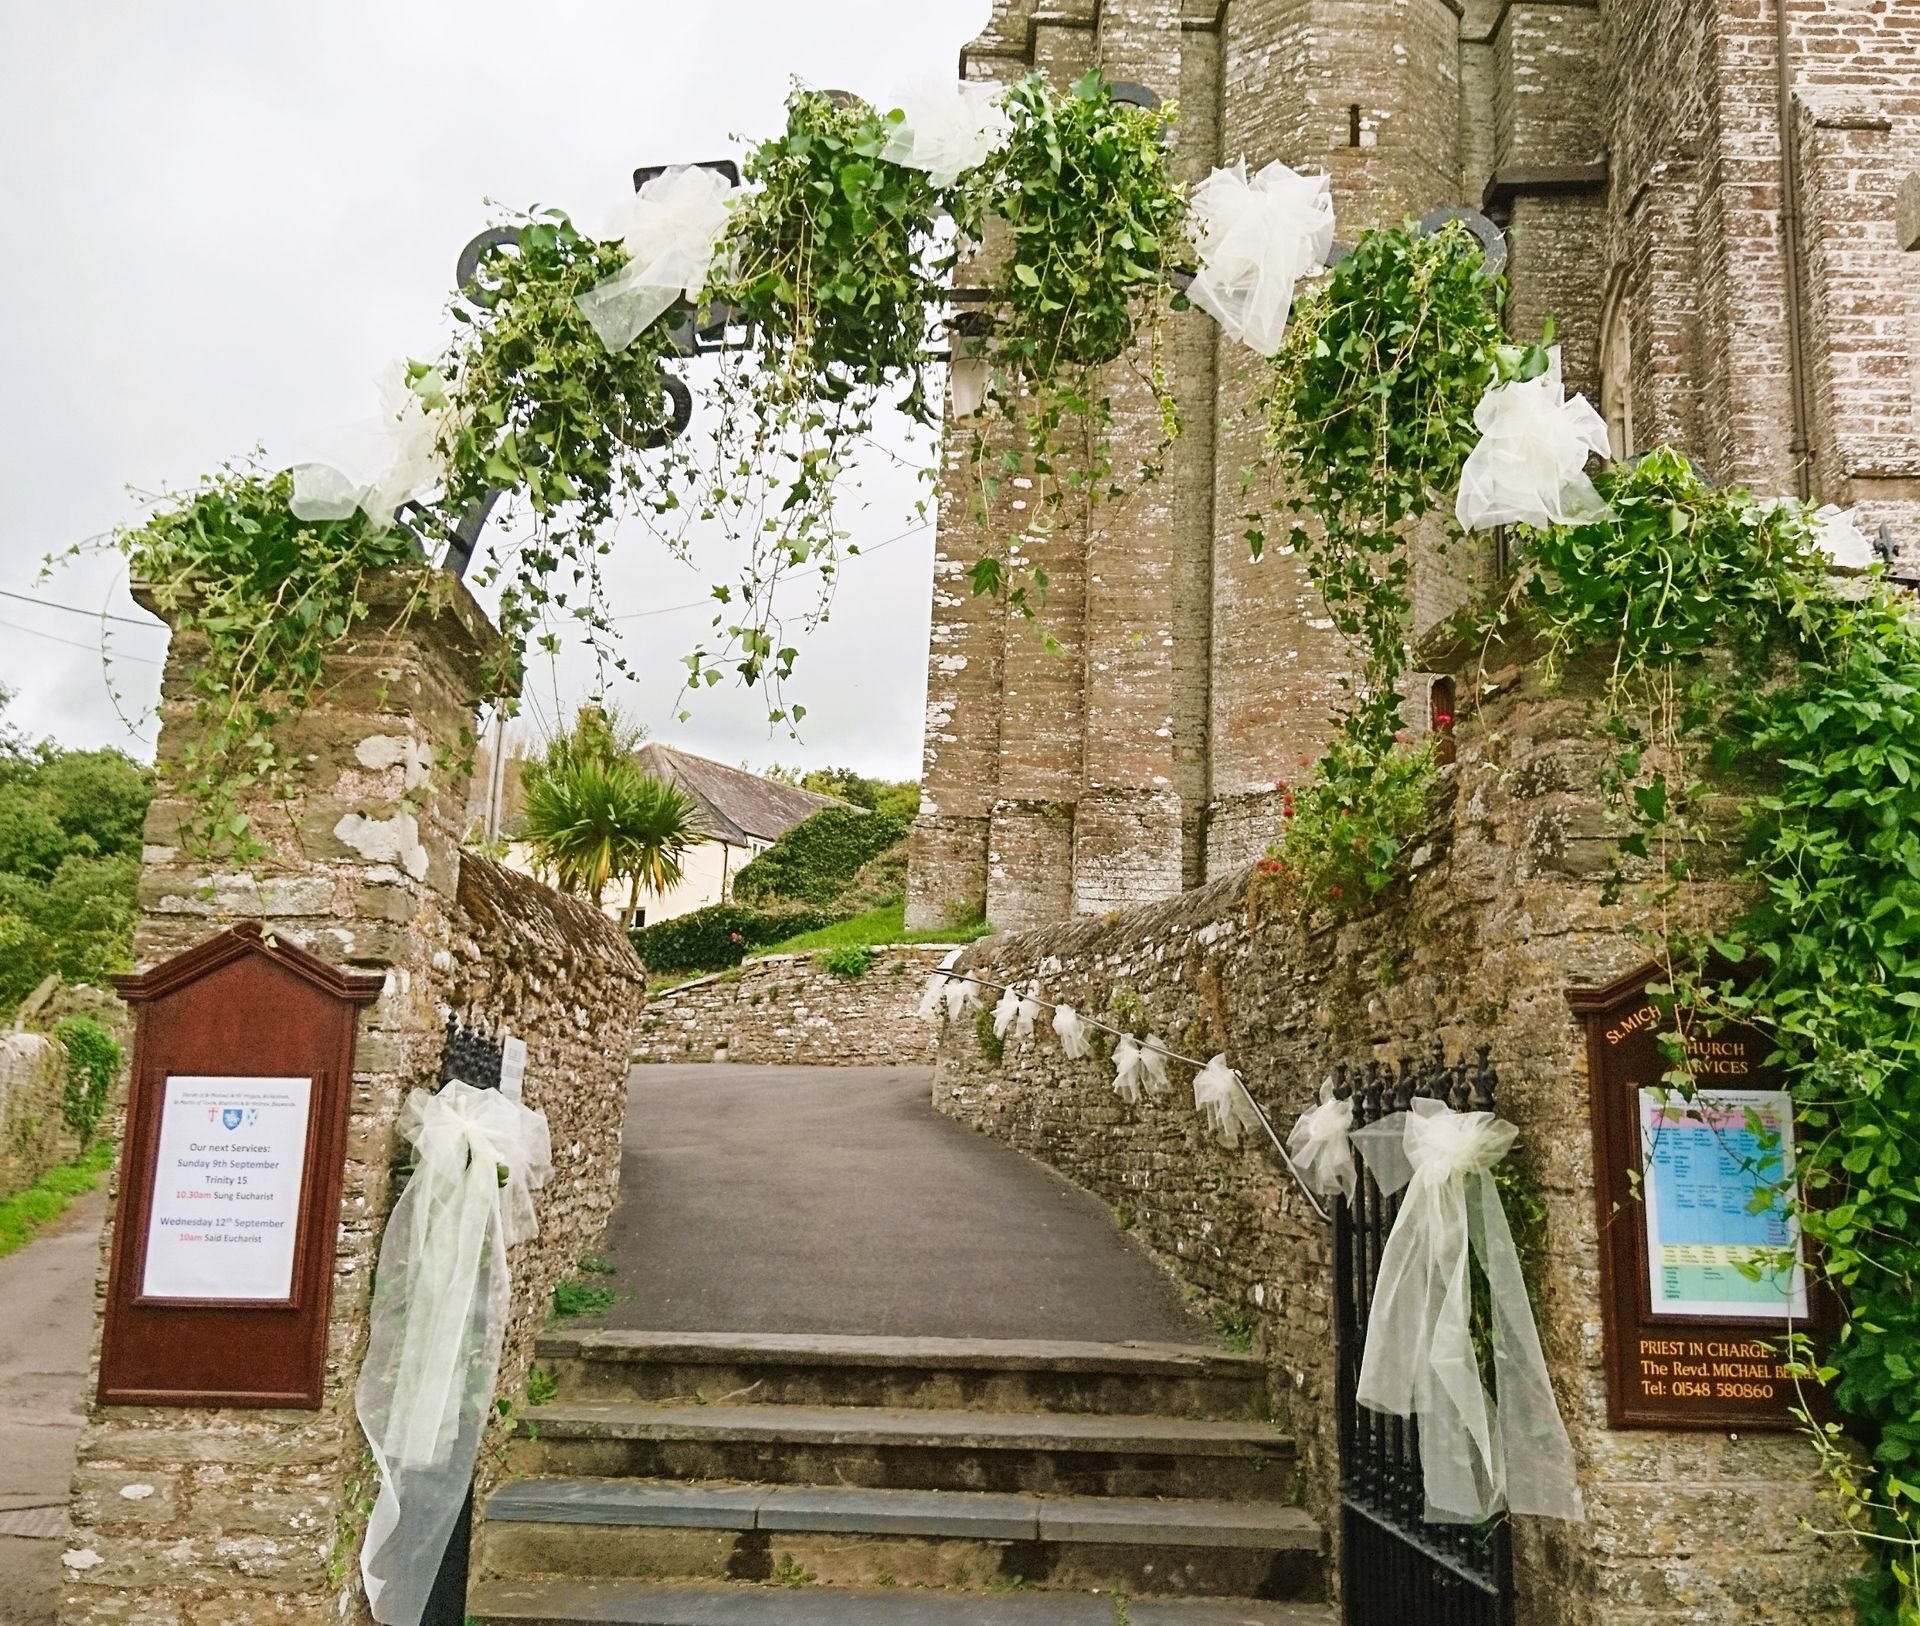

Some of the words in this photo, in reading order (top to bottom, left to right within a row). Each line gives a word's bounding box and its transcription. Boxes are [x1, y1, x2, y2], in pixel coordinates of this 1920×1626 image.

[1606, 1029, 1626, 1045] St.
[1685, 1042, 1745, 1056] HURCH
[189, 1143, 206, 1152] Our
[208, 1144, 229, 1152] next
[231, 1144, 271, 1153] Services:
[177, 1159, 210, 1169] Sunday
[213, 1160, 228, 1169] 9th
[229, 1160, 280, 1170] September
[205, 1176, 234, 1186] Trinity
[237, 1177, 248, 1185] 15
[176, 1191, 212, 1200] 10.30am
[213, 1192, 234, 1202] Sung
[236, 1192, 274, 1201] Eucharist
[160, 1217, 213, 1228] Wednesday
[234, 1218, 284, 1230] September
[180, 1234, 202, 1242] 10am
[204, 1234, 222, 1243] Said
[224, 1234, 262, 1244] Eucharist
[1640, 1341, 1685, 1355] PRIEST
[1689, 1342, 1703, 1356] IN
[1641, 1360, 1668, 1376] The
[1673, 1361, 1710, 1378] Revd.
[1713, 1363, 1772, 1379] MICHAEL
[1641, 1380, 1667, 1395] Tel:
[1672, 1381, 1711, 1397] 01548
[1716, 1383, 1773, 1398] 580860
